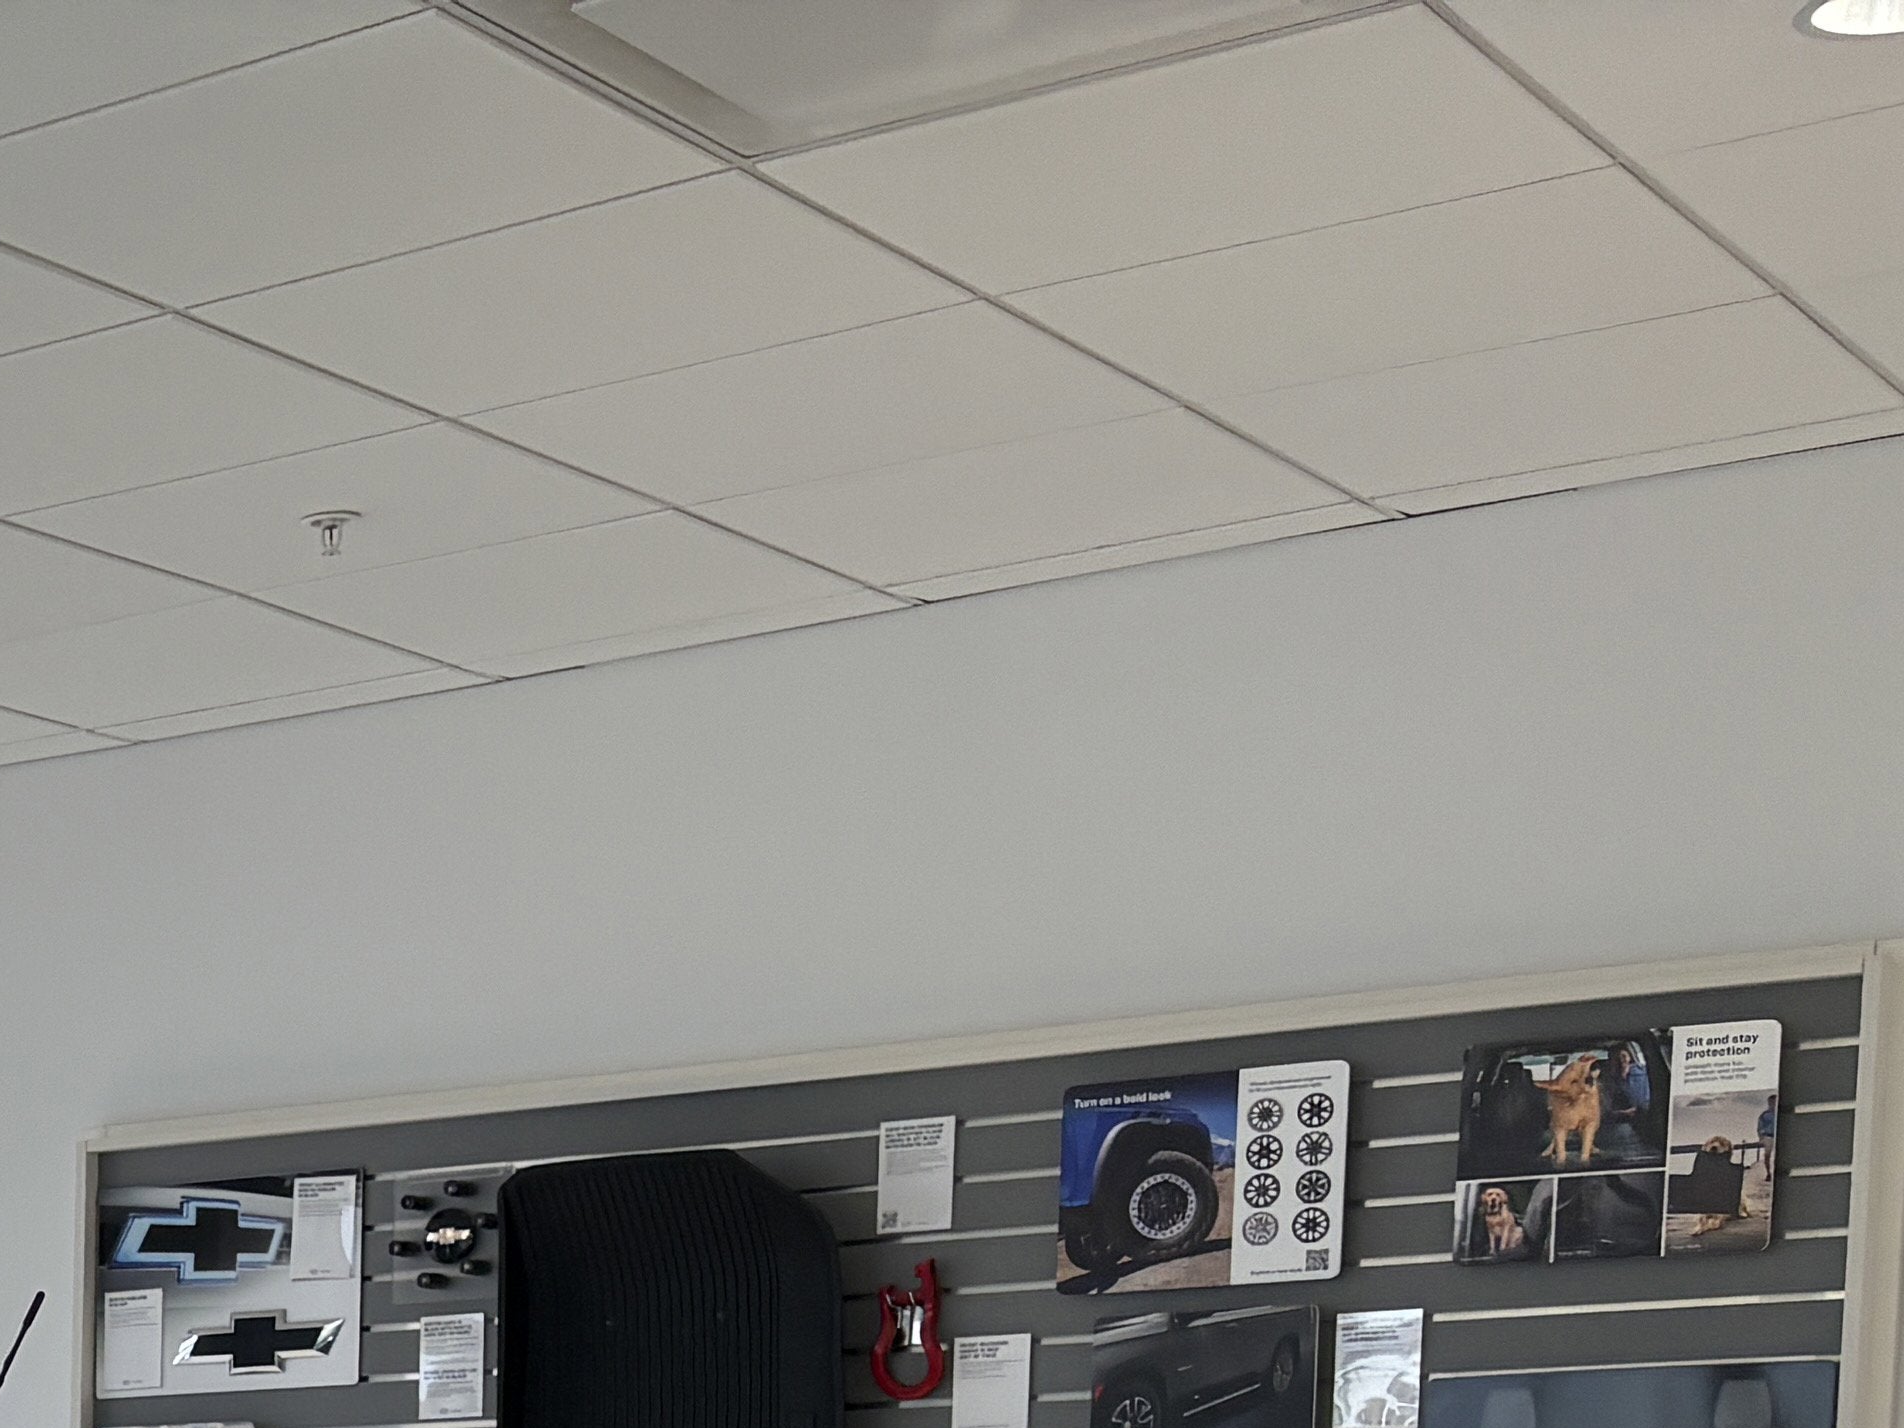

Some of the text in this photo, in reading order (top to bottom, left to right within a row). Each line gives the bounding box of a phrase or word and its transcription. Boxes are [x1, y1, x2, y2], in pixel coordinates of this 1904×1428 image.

[1686, 1034, 1759, 1047] Sit and stay
[1685, 1046, 1750, 1060] protection
[1074, 1098, 1097, 1109] Turn
[1099, 1097, 1112, 1106] on
[1123, 1092, 1147, 1104] bold
